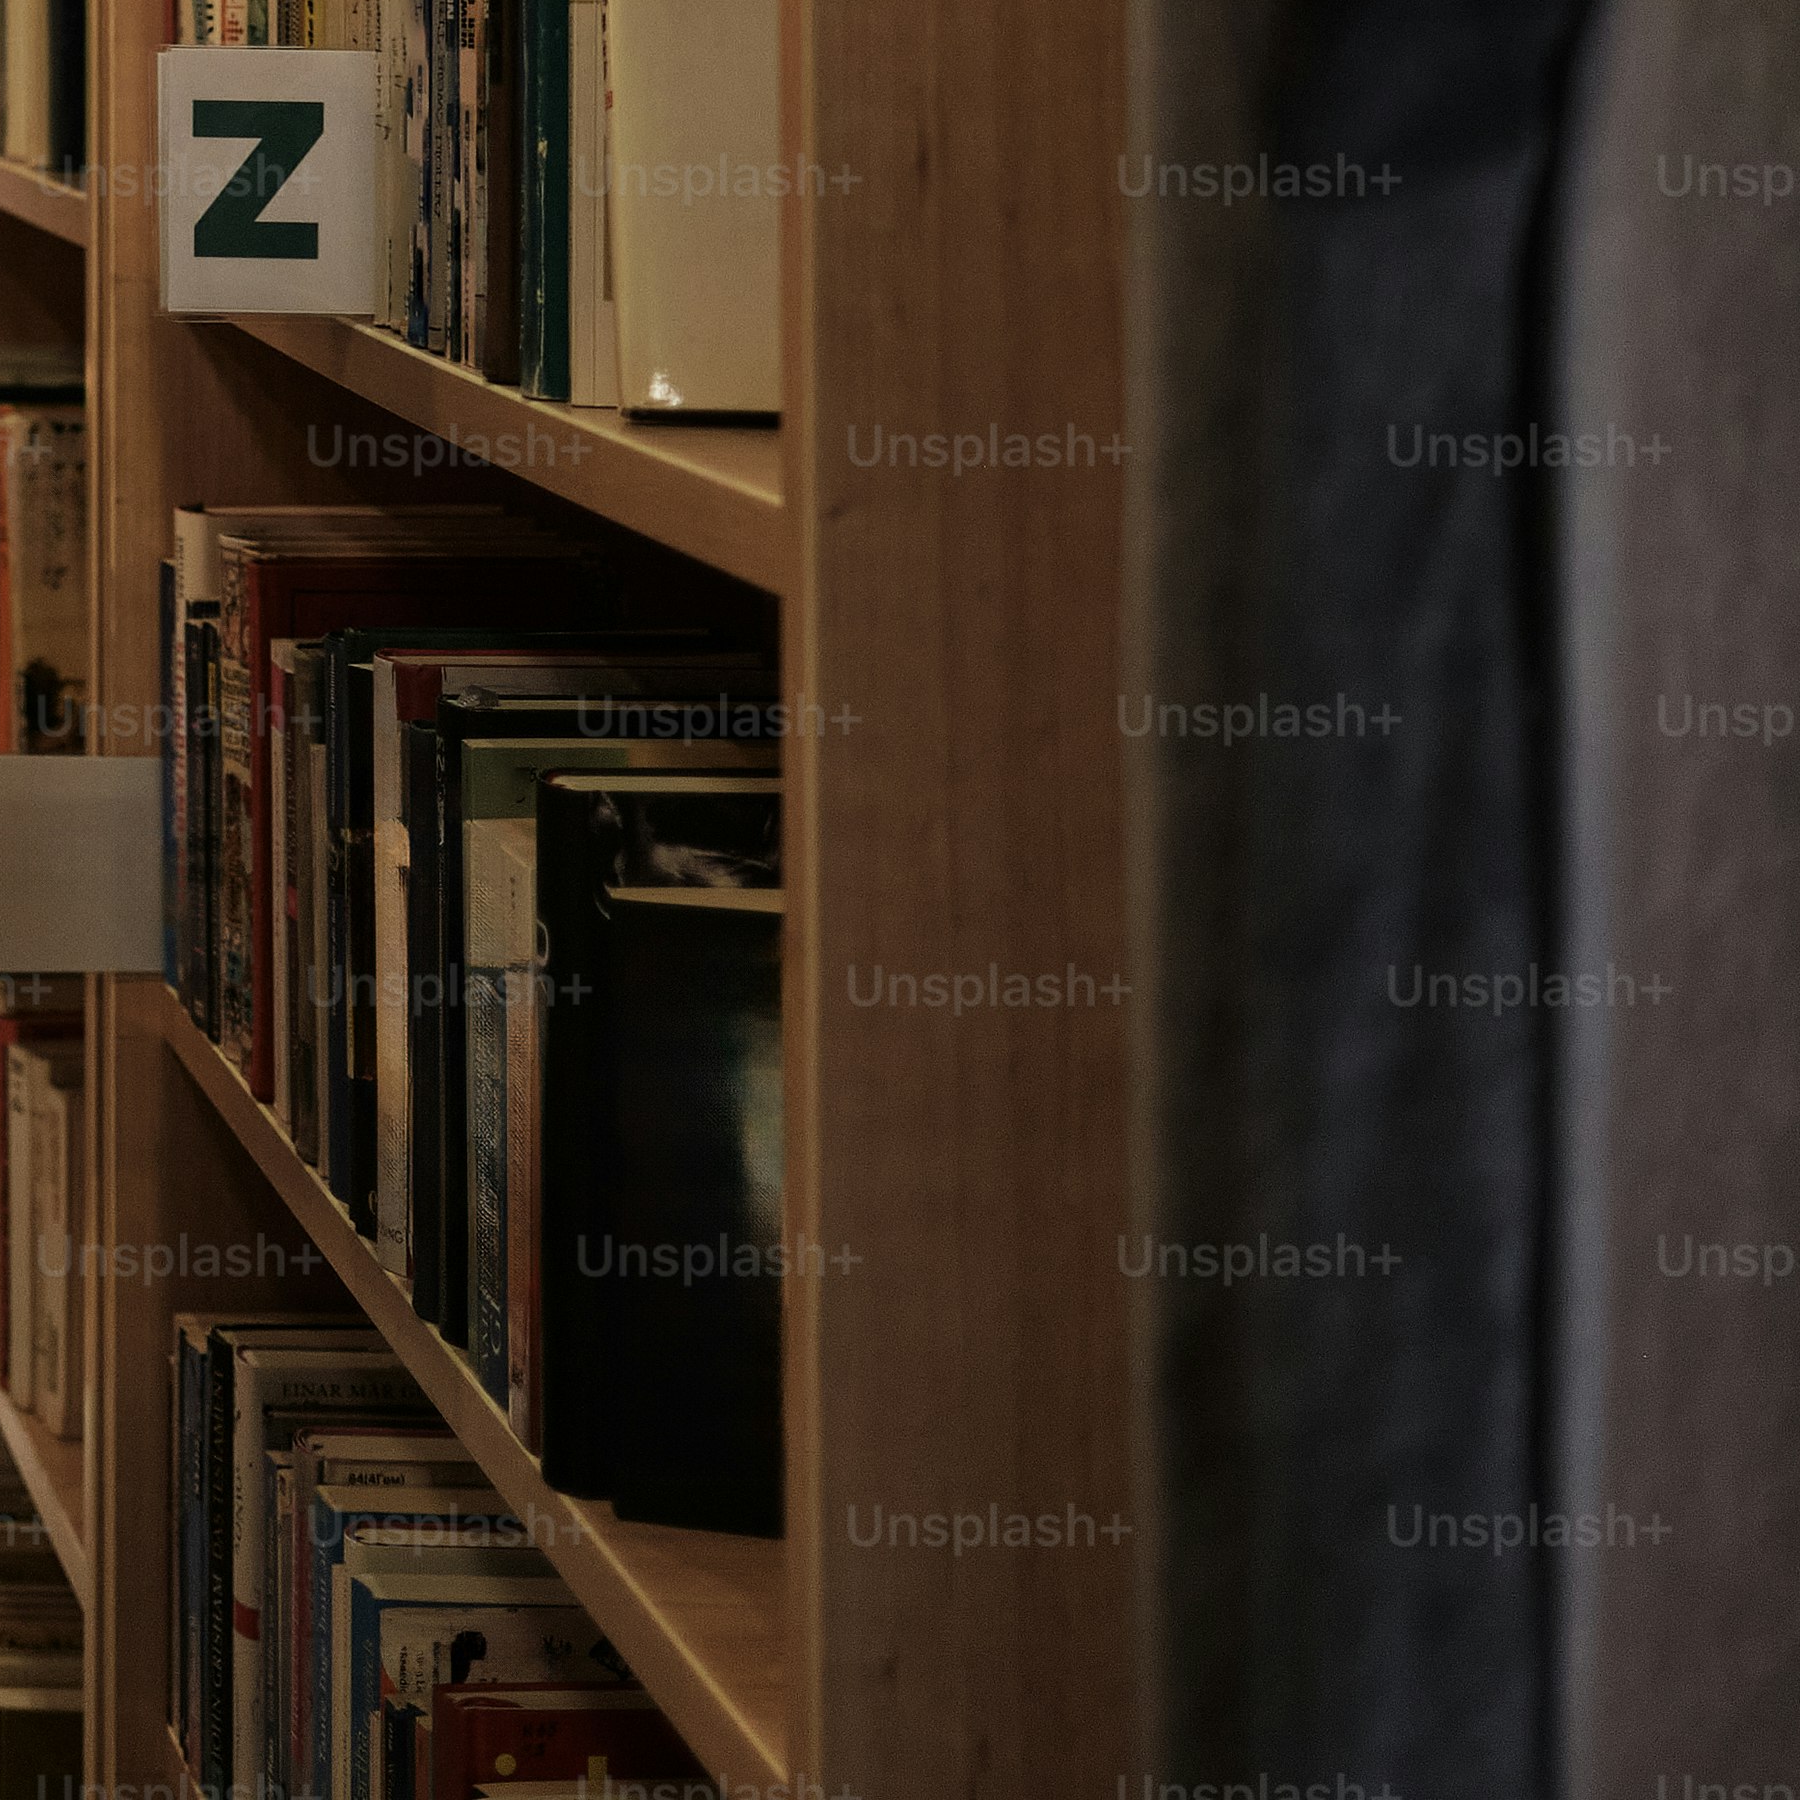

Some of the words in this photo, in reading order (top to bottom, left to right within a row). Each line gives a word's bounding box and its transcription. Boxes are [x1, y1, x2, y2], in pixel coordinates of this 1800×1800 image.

[435, 54, 446, 129] Zweig
[192, 100, 324, 259] Z
[433, 134, 444, 219] Arnold
[283, 1382, 342, 1398] EINAR
[210, 1365, 226, 1506] TESTAMENT
[208, 1573, 224, 1690] GRISHAM
[209, 1696, 226, 1762] JOHN
